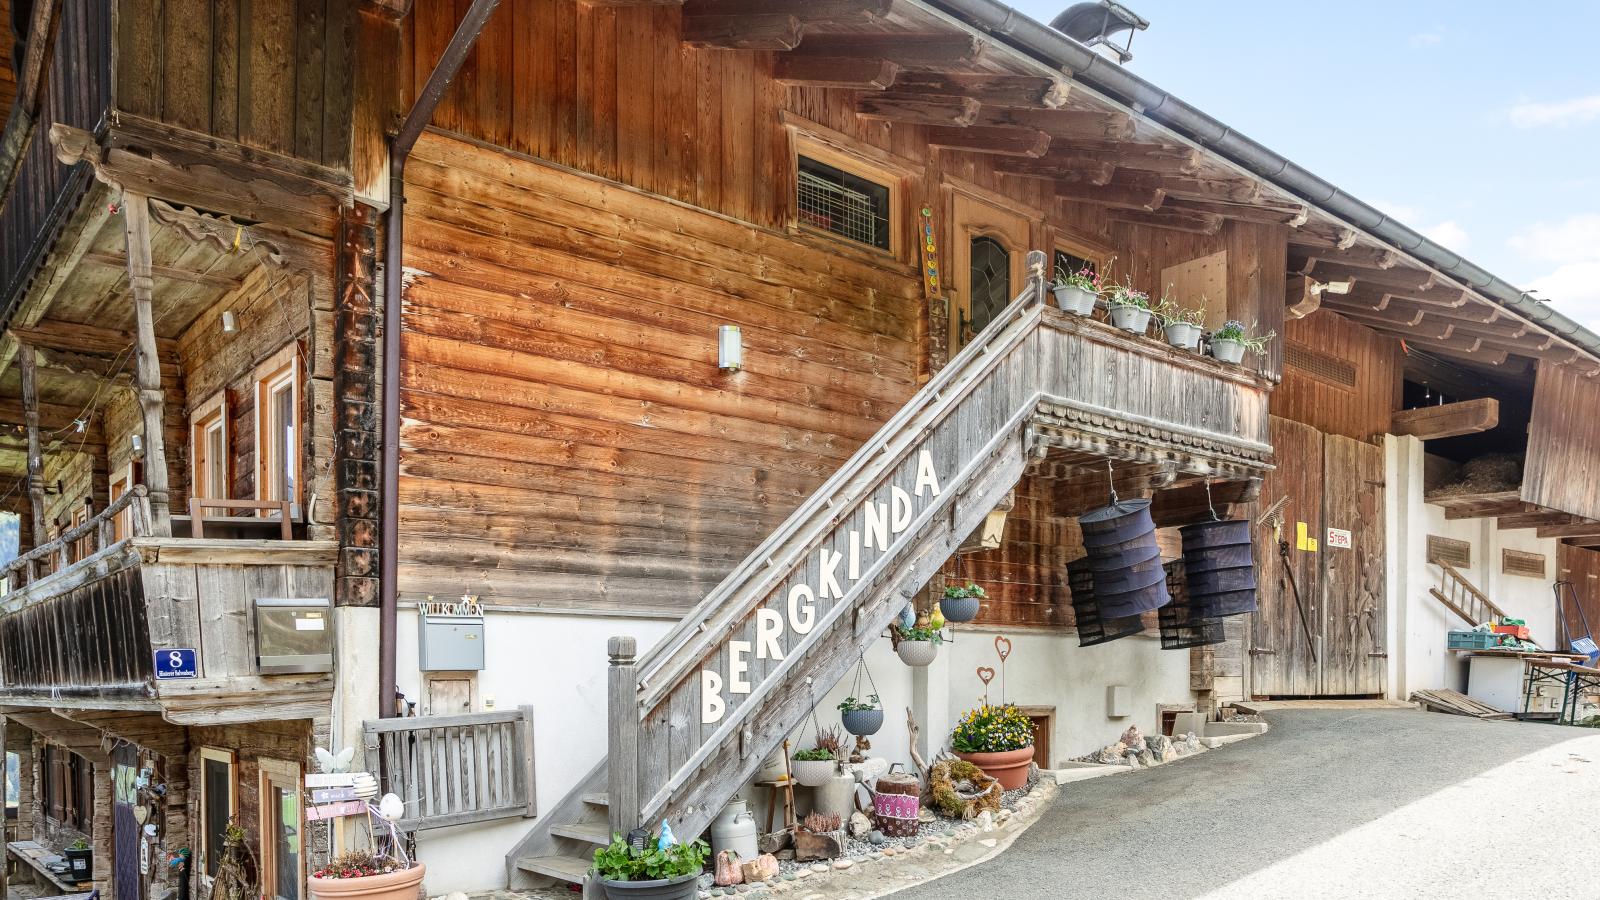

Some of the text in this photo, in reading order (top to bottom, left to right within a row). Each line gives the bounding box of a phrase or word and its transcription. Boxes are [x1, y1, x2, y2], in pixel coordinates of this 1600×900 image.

[702, 450, 940, 724] BERGKINDA
[419, 602, 484, 616] WILLKOMMEN
[170, 651, 182, 667] 8
